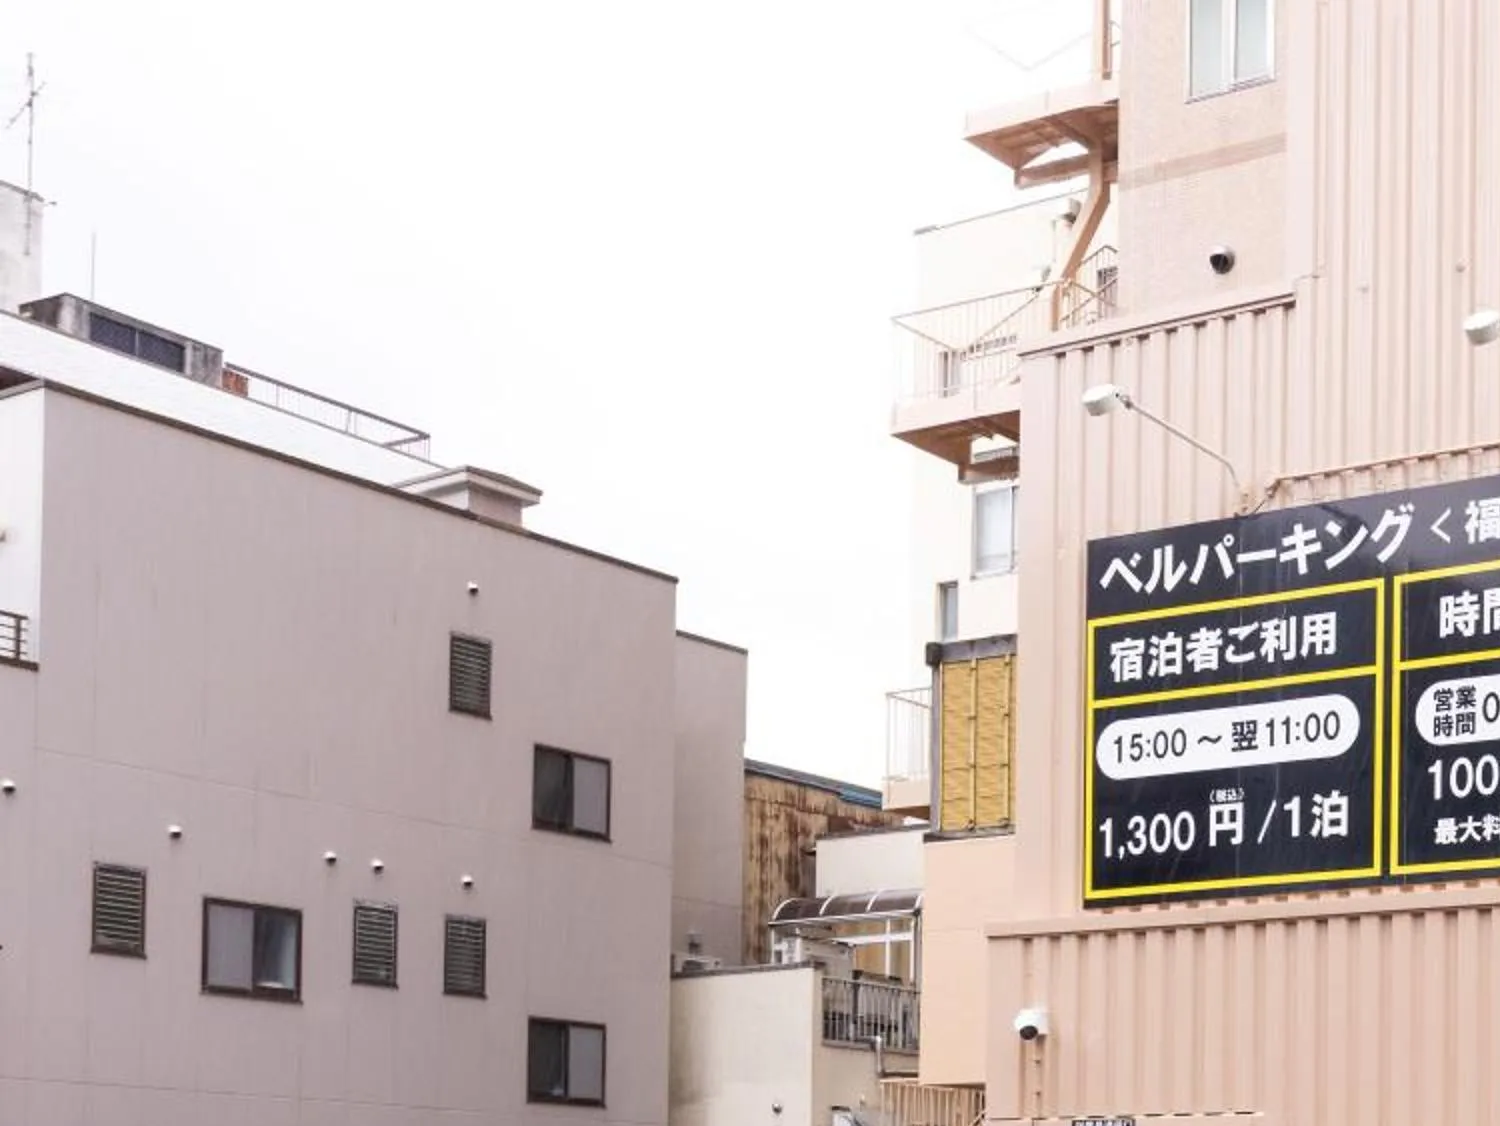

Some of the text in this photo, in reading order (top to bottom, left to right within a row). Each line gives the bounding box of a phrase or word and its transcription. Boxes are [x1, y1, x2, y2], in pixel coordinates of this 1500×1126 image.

[1099, 503, 1416, 596] ベルパーキング
[1110, 611, 1338, 684] 宿泊者ご利用
[1433, 686, 1477, 713] 営業
[1433, 711, 1477, 737] 時間
